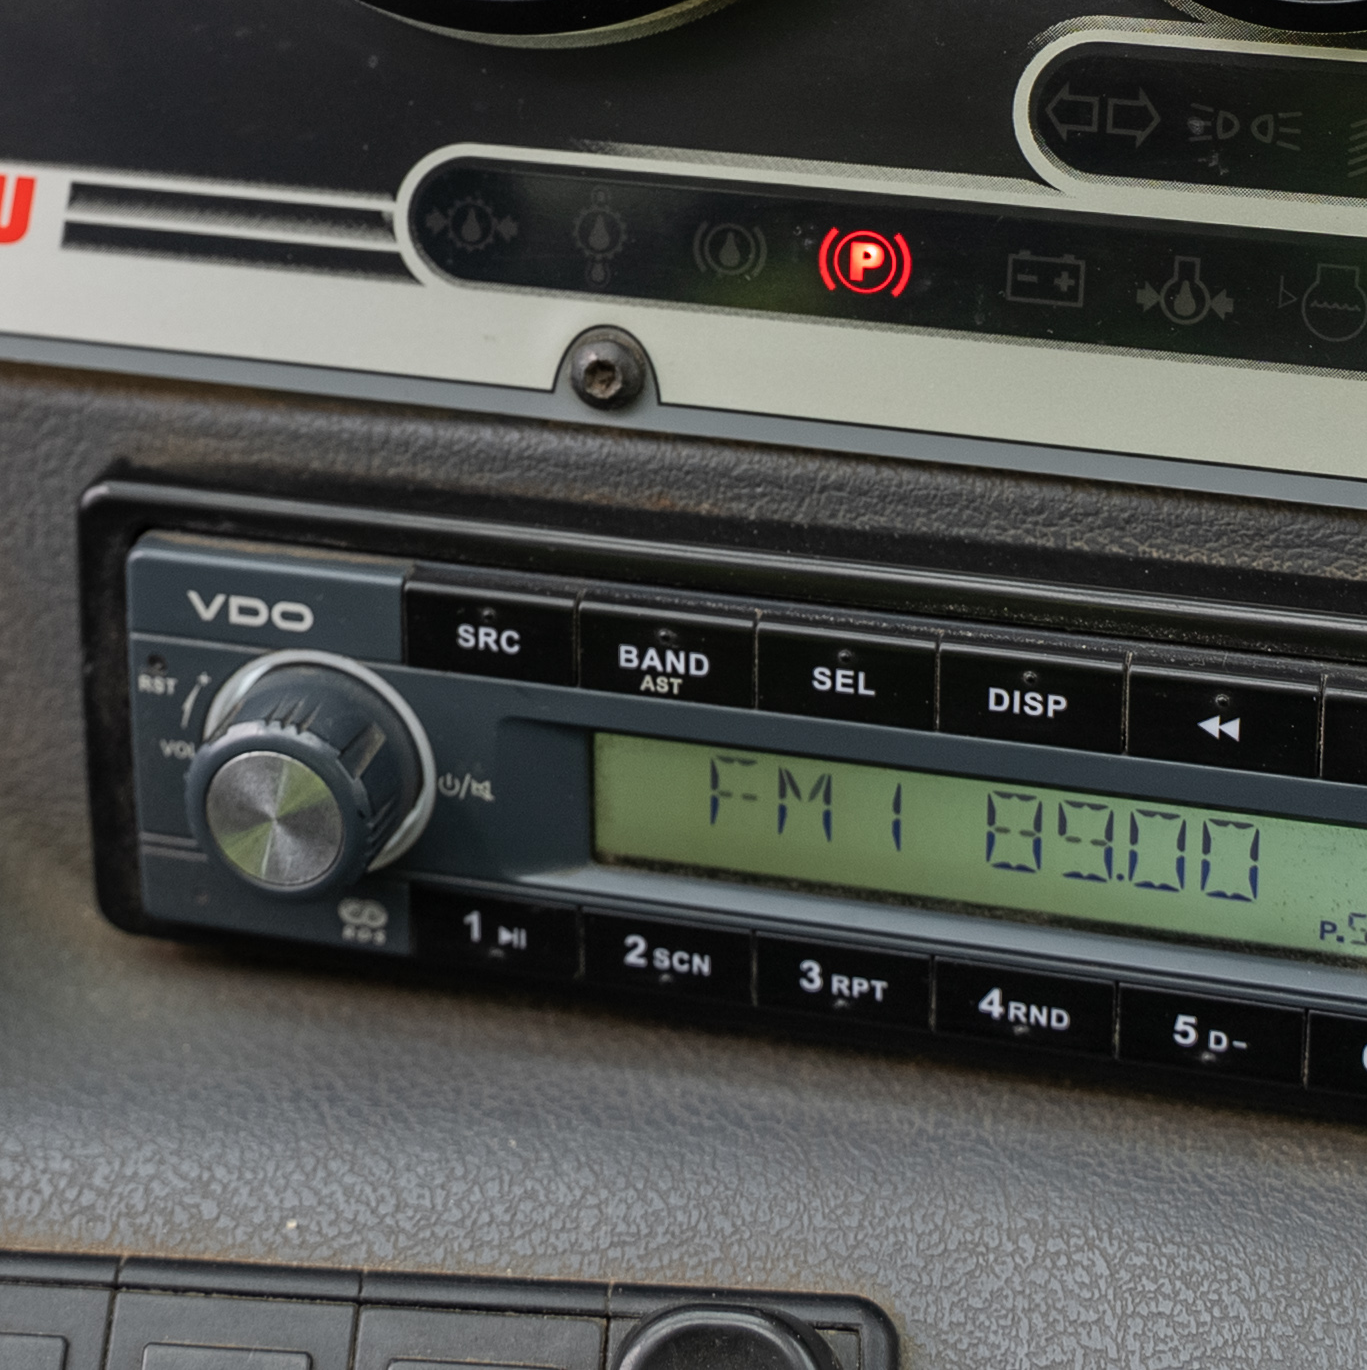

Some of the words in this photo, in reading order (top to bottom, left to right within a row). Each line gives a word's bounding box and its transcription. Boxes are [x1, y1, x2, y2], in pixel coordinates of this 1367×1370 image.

[850, 241, 885, 281] P
[187, 590, 314, 632] VDO
[457, 624, 521, 654] SRC
[619, 644, 710, 677] BAND
[138, 674, 177, 694] RST
[639, 676, 682, 696] AST
[812, 666, 876, 697] SEL
[988, 687, 1068, 719] DISP
[463, 911, 482, 943] 1
[624, 935, 648, 968] 2
[652, 947, 711, 976] SCN
[799, 959, 823, 992] 3
[832, 974, 888, 1001] RPT
[978, 988, 1004, 1020] 4
[1008, 1002, 1070, 1031] RND
[1173, 1014, 1198, 1048] 5
